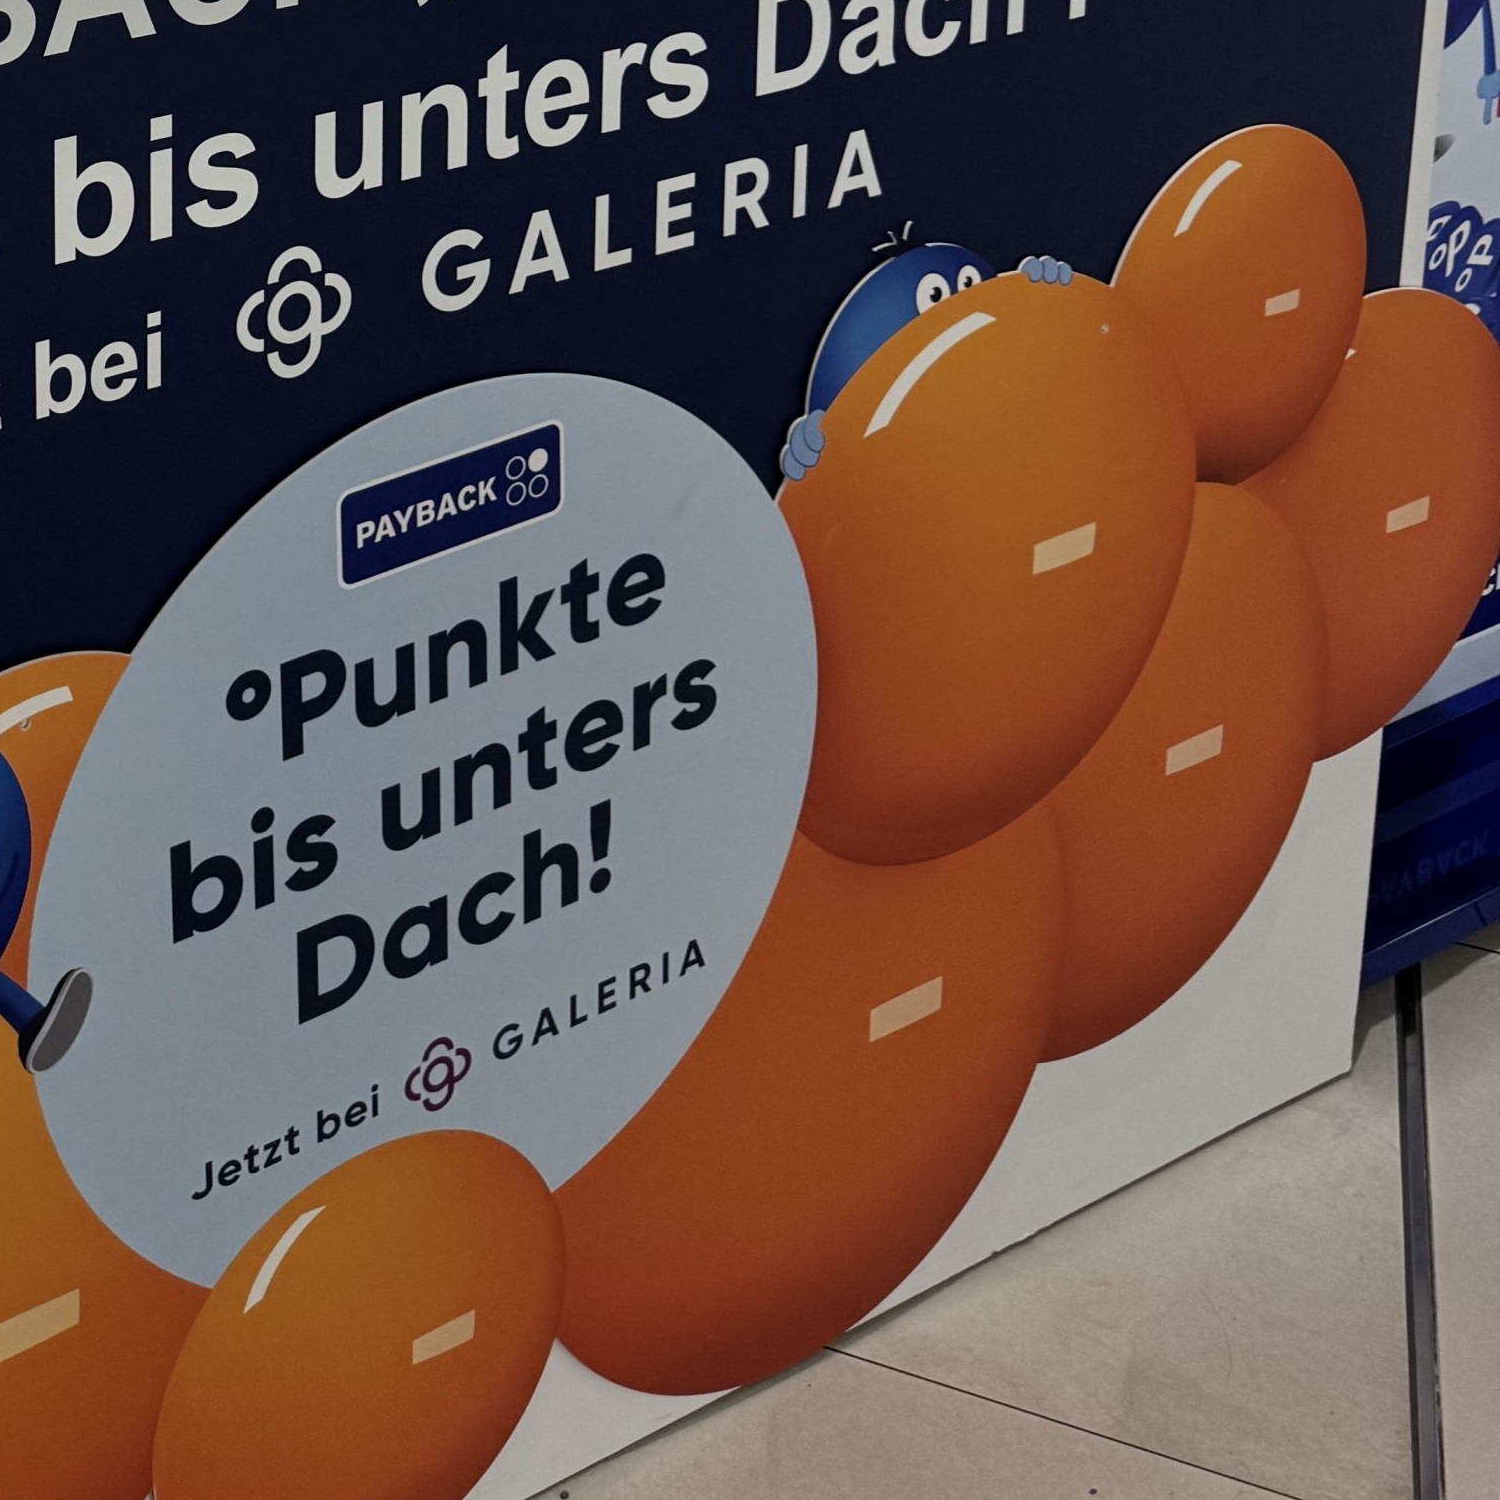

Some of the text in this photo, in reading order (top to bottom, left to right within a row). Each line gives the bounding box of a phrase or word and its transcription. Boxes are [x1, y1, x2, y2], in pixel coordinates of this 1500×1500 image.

[54, 115, 258, 266] bis
[313, 27, 709, 200] unters
[35, 311, 162, 421] bei
[421, 129, 883, 312] GALERIA
[355, 475, 498, 550] PAYBACK
[169, 658, 718, 944] bis unters
[296, 798, 613, 1026] Dach!
[191, 938, 707, 1201] Jetzt bei GALERIA
